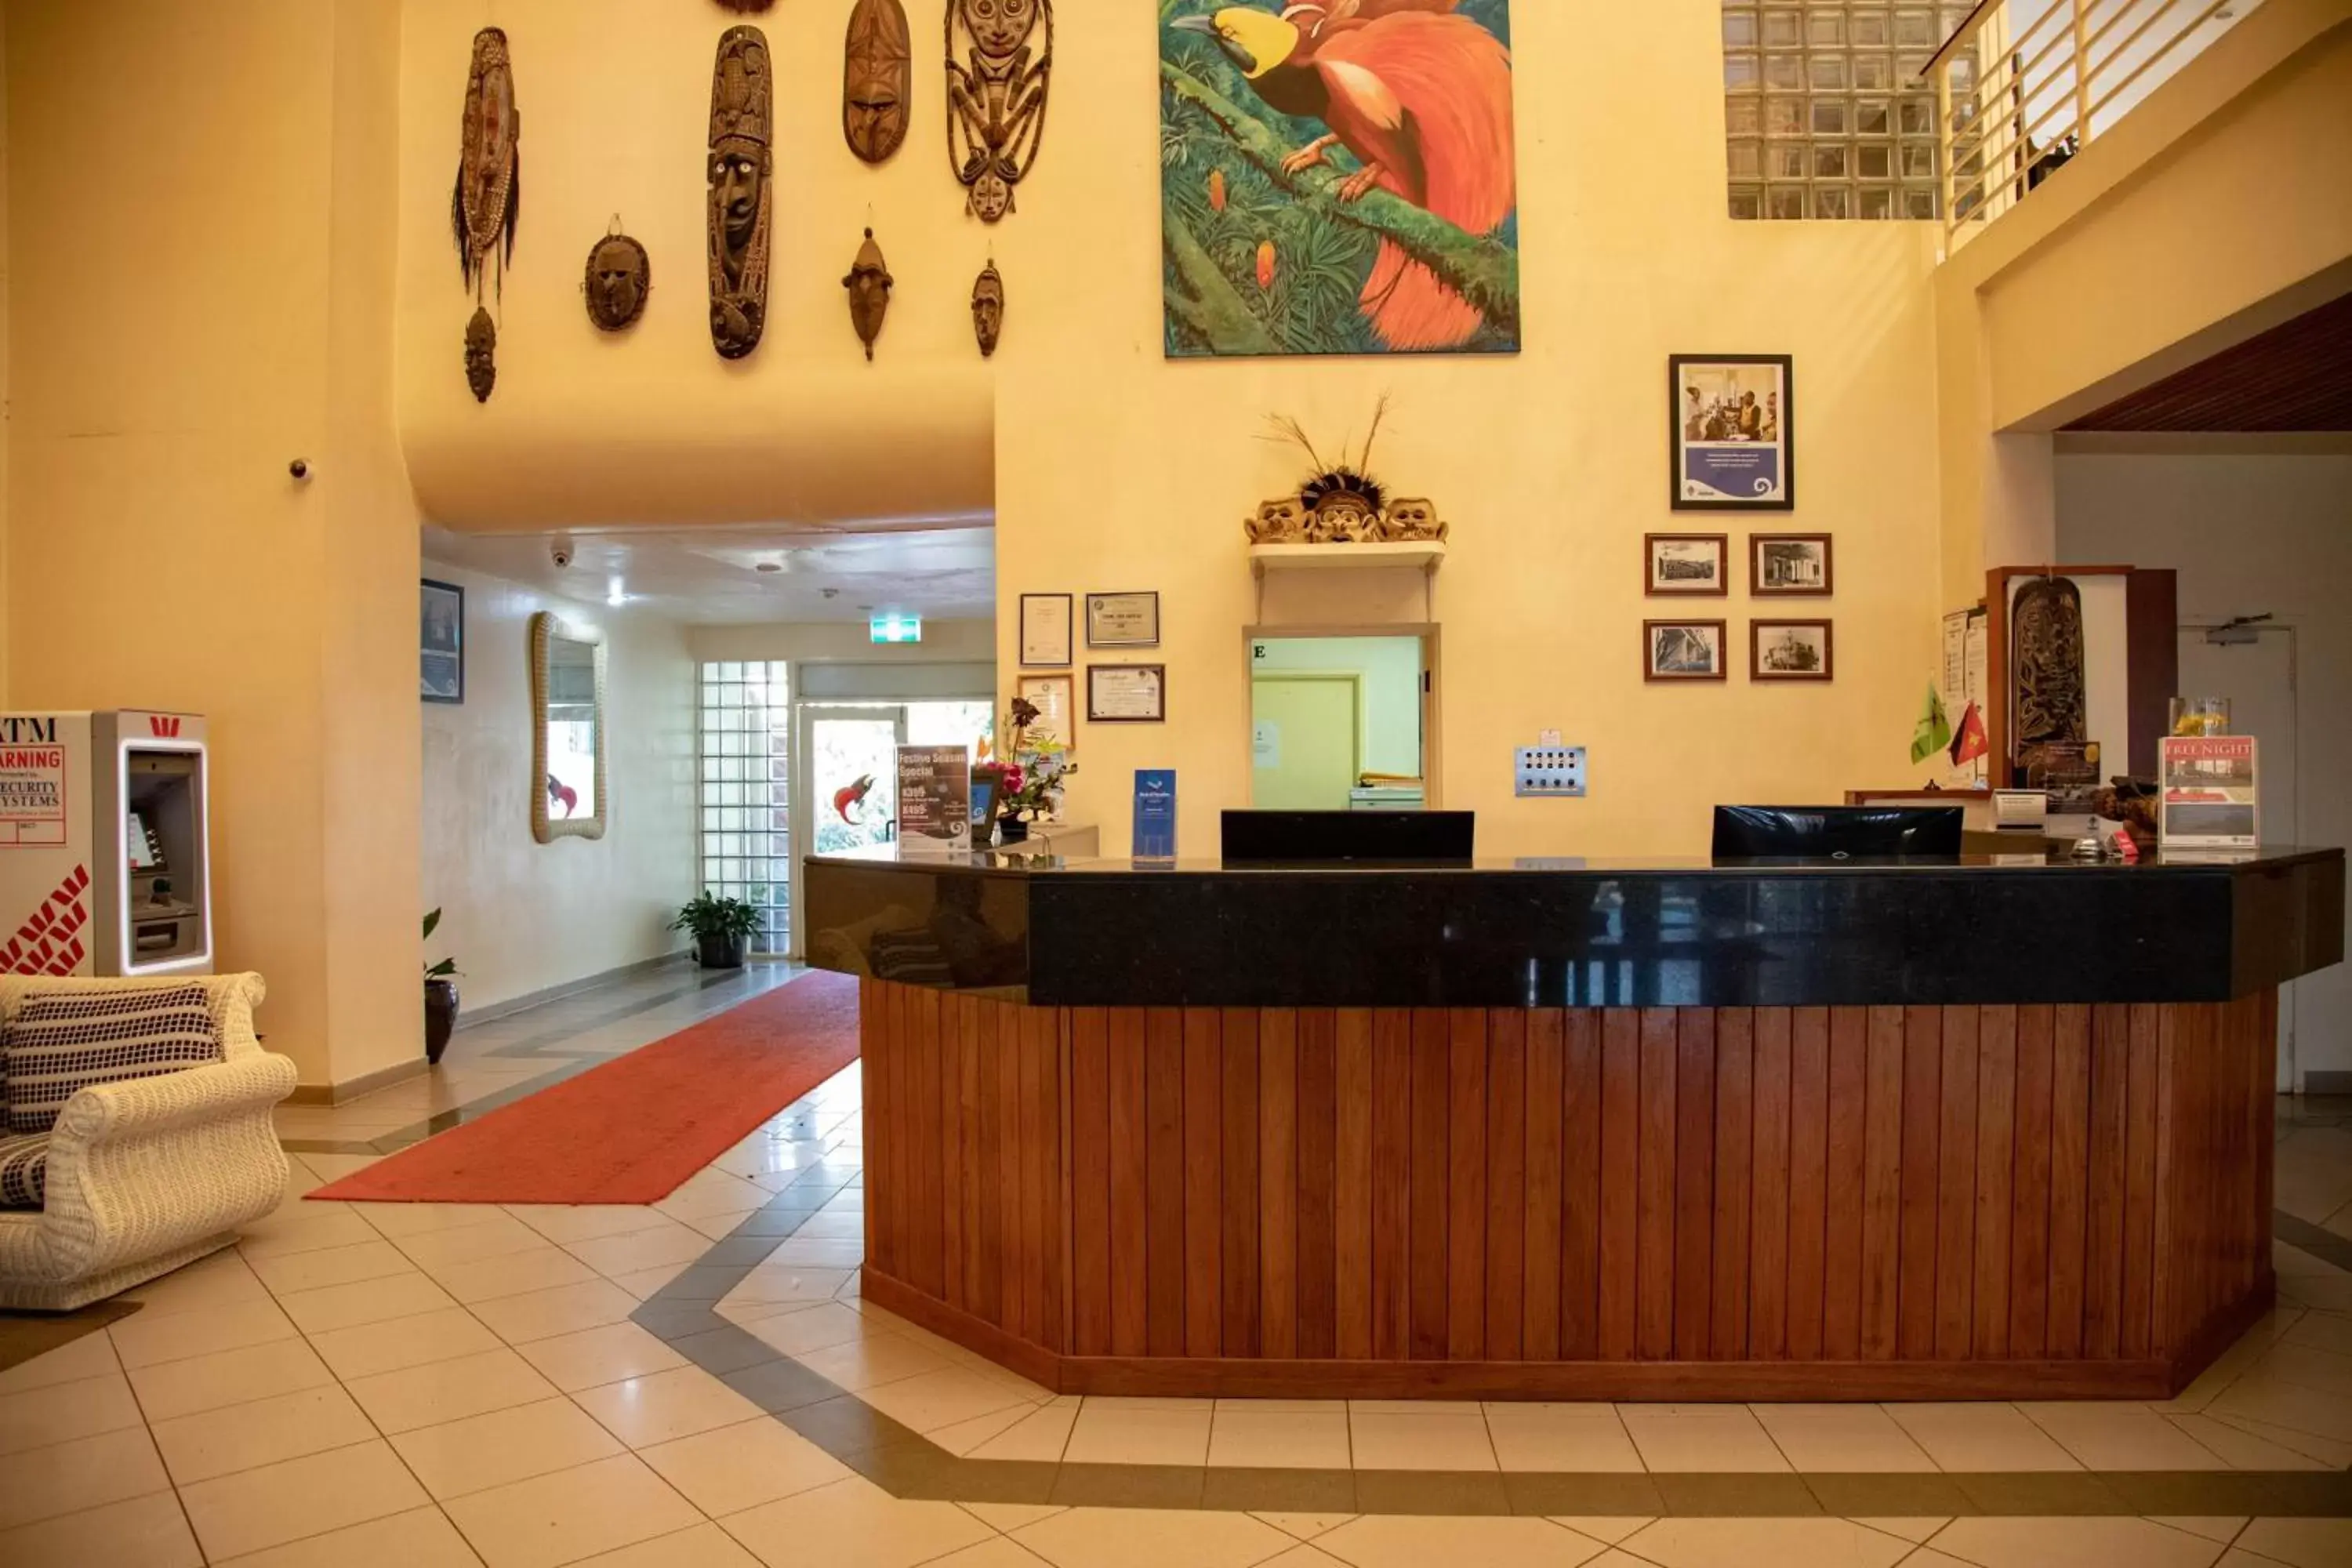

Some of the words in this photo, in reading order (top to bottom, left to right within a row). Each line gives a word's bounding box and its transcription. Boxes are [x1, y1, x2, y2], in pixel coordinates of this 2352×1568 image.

[1254, 645, 1265, 658] E
[2201, 743, 2252, 755] NIGHT
[899, 753, 931, 764] Festive
[899, 766, 934, 779] Special
